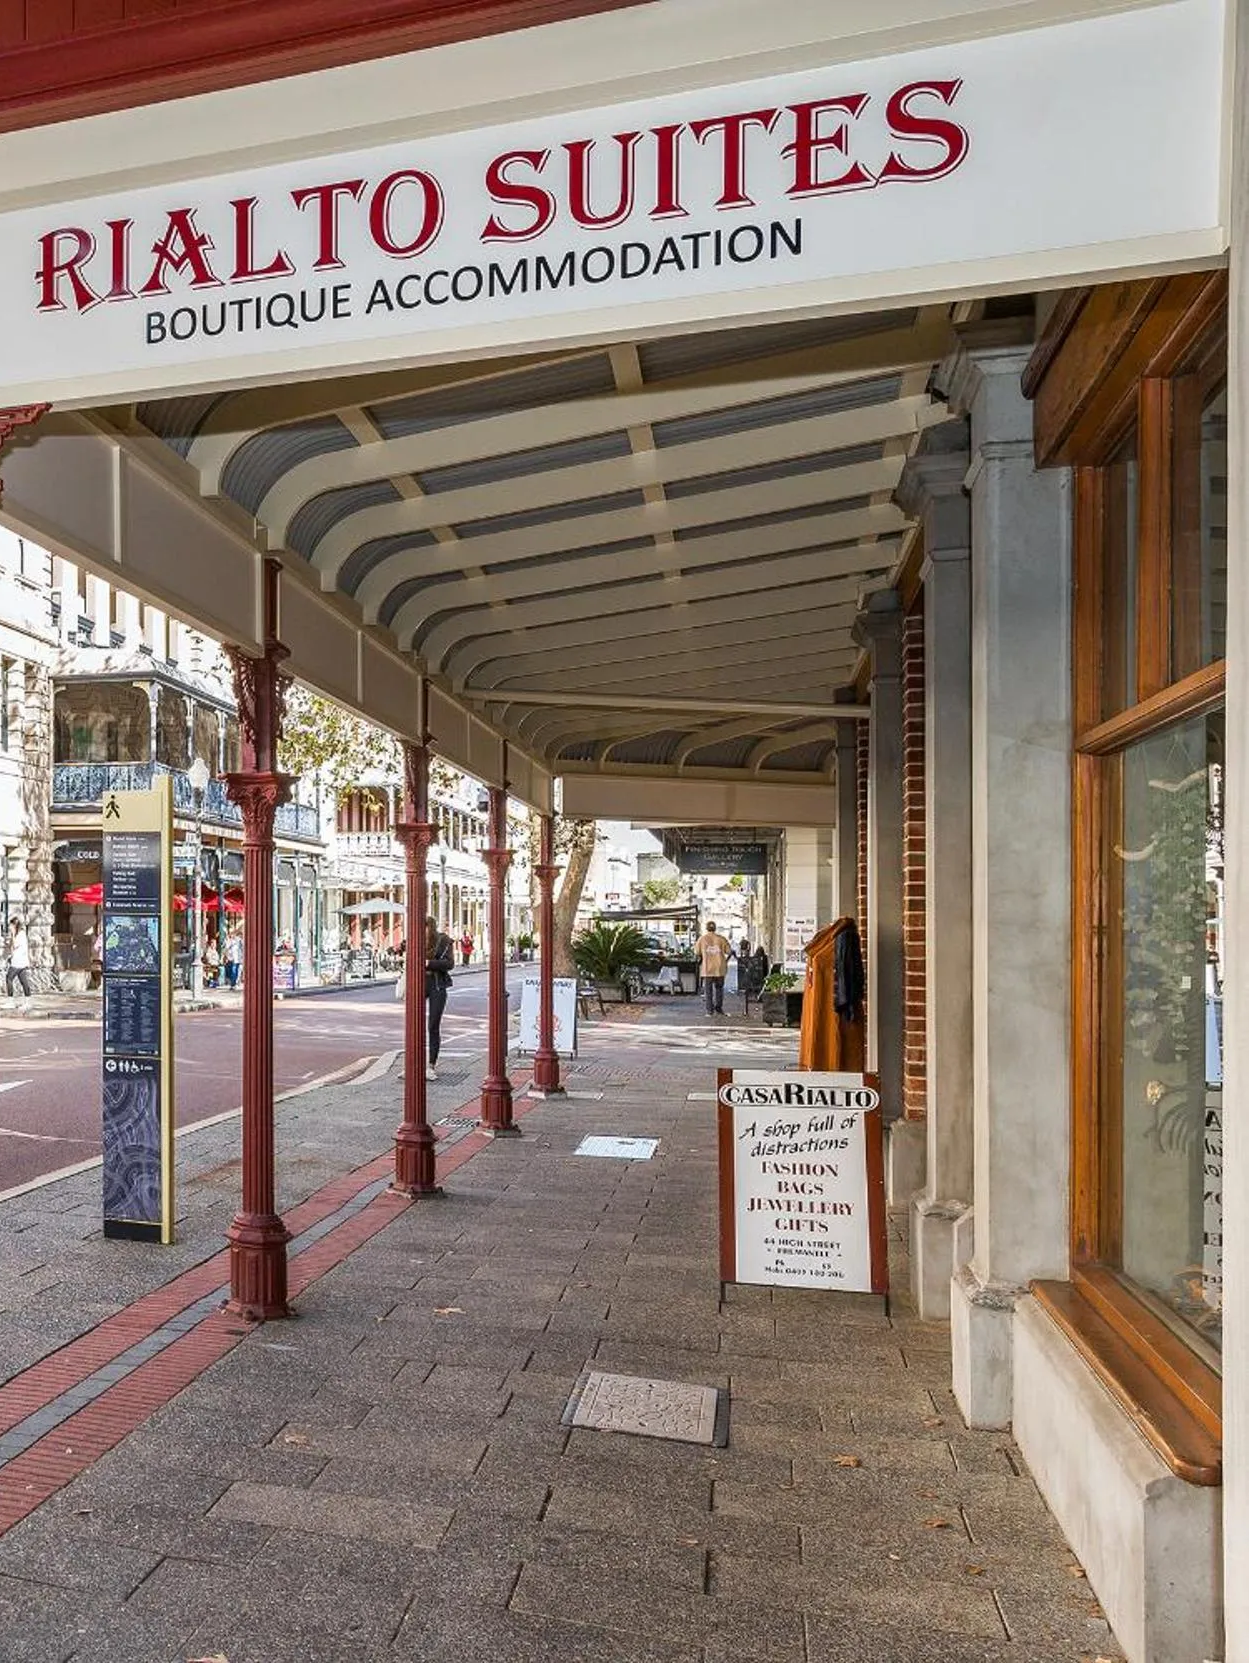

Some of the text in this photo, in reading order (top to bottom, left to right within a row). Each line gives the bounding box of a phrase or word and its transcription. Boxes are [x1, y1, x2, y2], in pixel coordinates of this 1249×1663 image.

[35, 77, 970, 314] RIALTO SUITES
[146, 217, 804, 345] BOUTIQUE ACCOMMODATION
[739, 1113, 859, 1140] A shop full of
[750, 1137, 849, 1157] distractions
[762, 1161, 839, 1177] FASHION
[778, 1181, 824, 1195] BAGS
[747, 1198, 854, 1215] JEWELLERY
[775, 1218, 829, 1233] GIFTS
